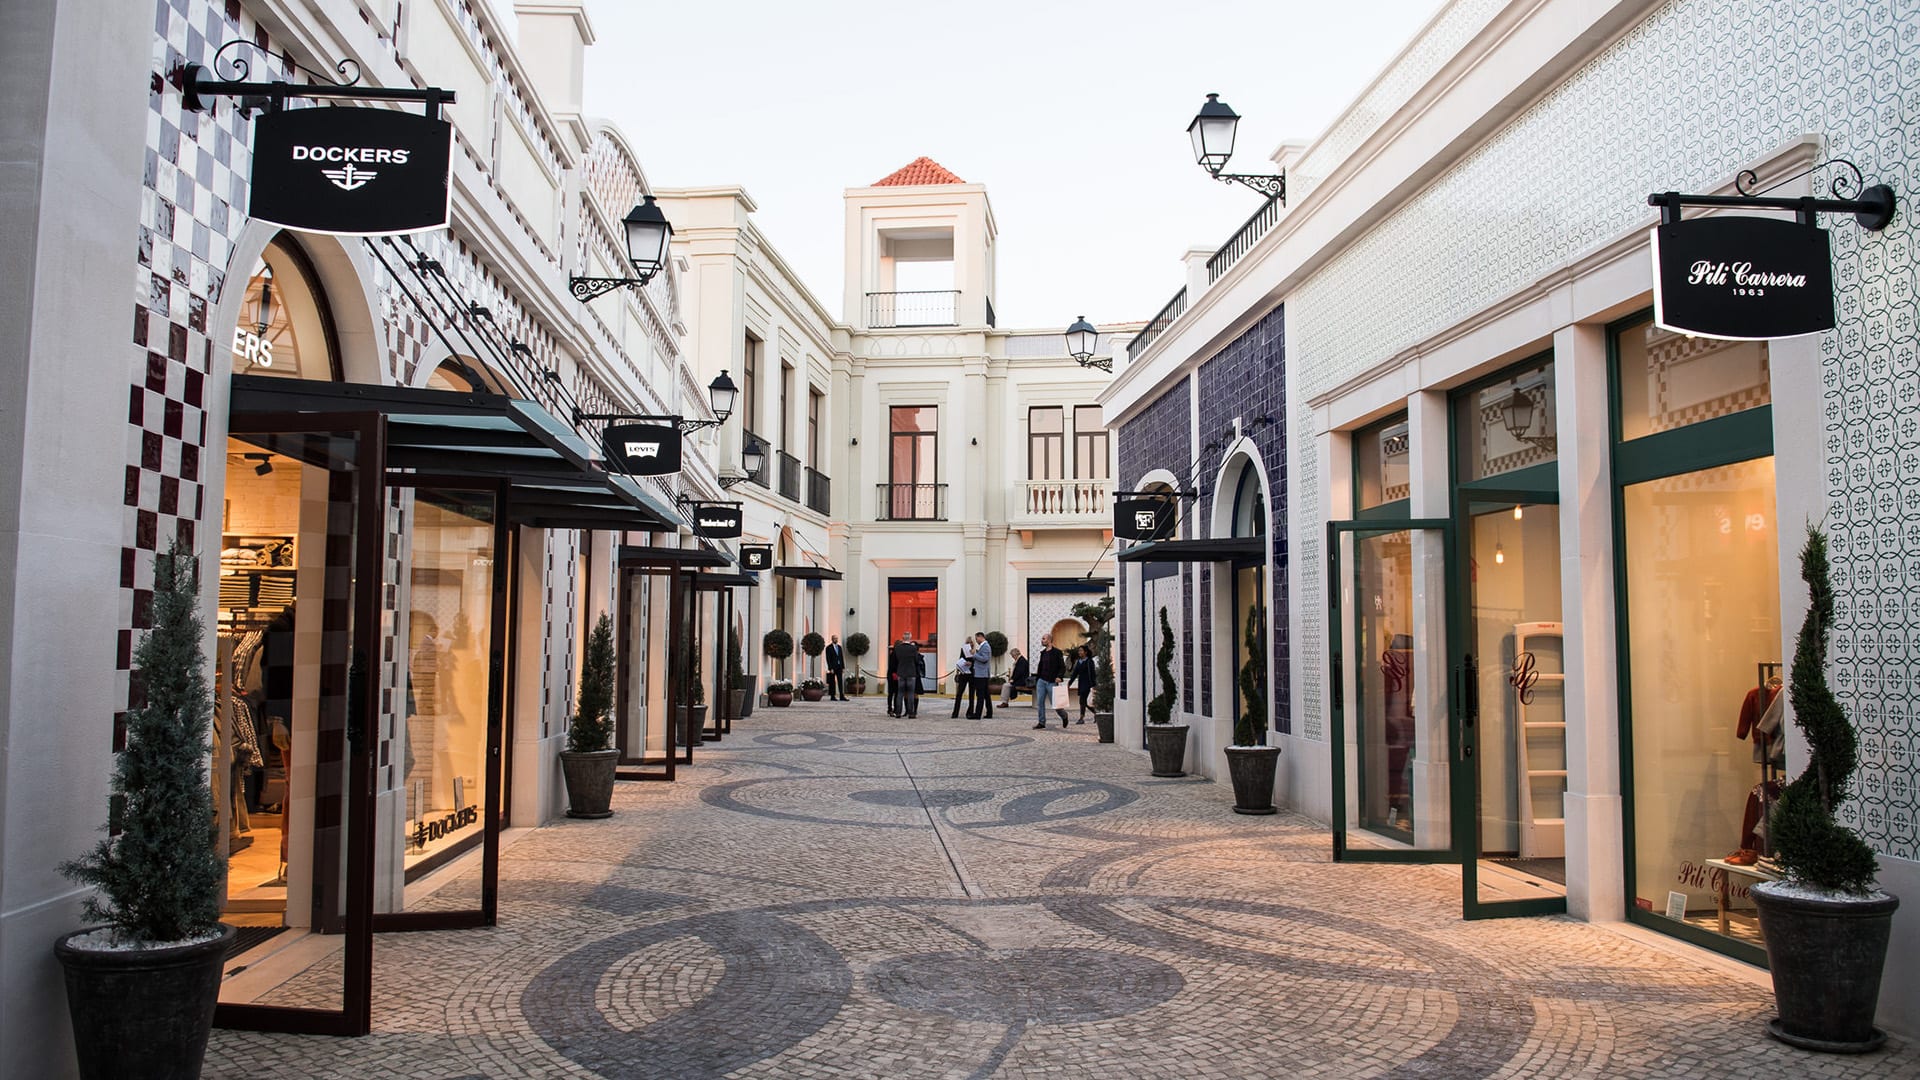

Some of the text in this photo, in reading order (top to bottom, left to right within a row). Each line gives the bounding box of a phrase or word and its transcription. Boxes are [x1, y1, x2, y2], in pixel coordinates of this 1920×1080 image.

[292, 145, 410, 164] DOCKERS
[1687, 260, 1807, 288] Pili Carrera
[1733, 288, 1765, 296] 1963
[428, 804, 478, 842] DOCKERS
[1678, 860, 1706, 889] Pili
